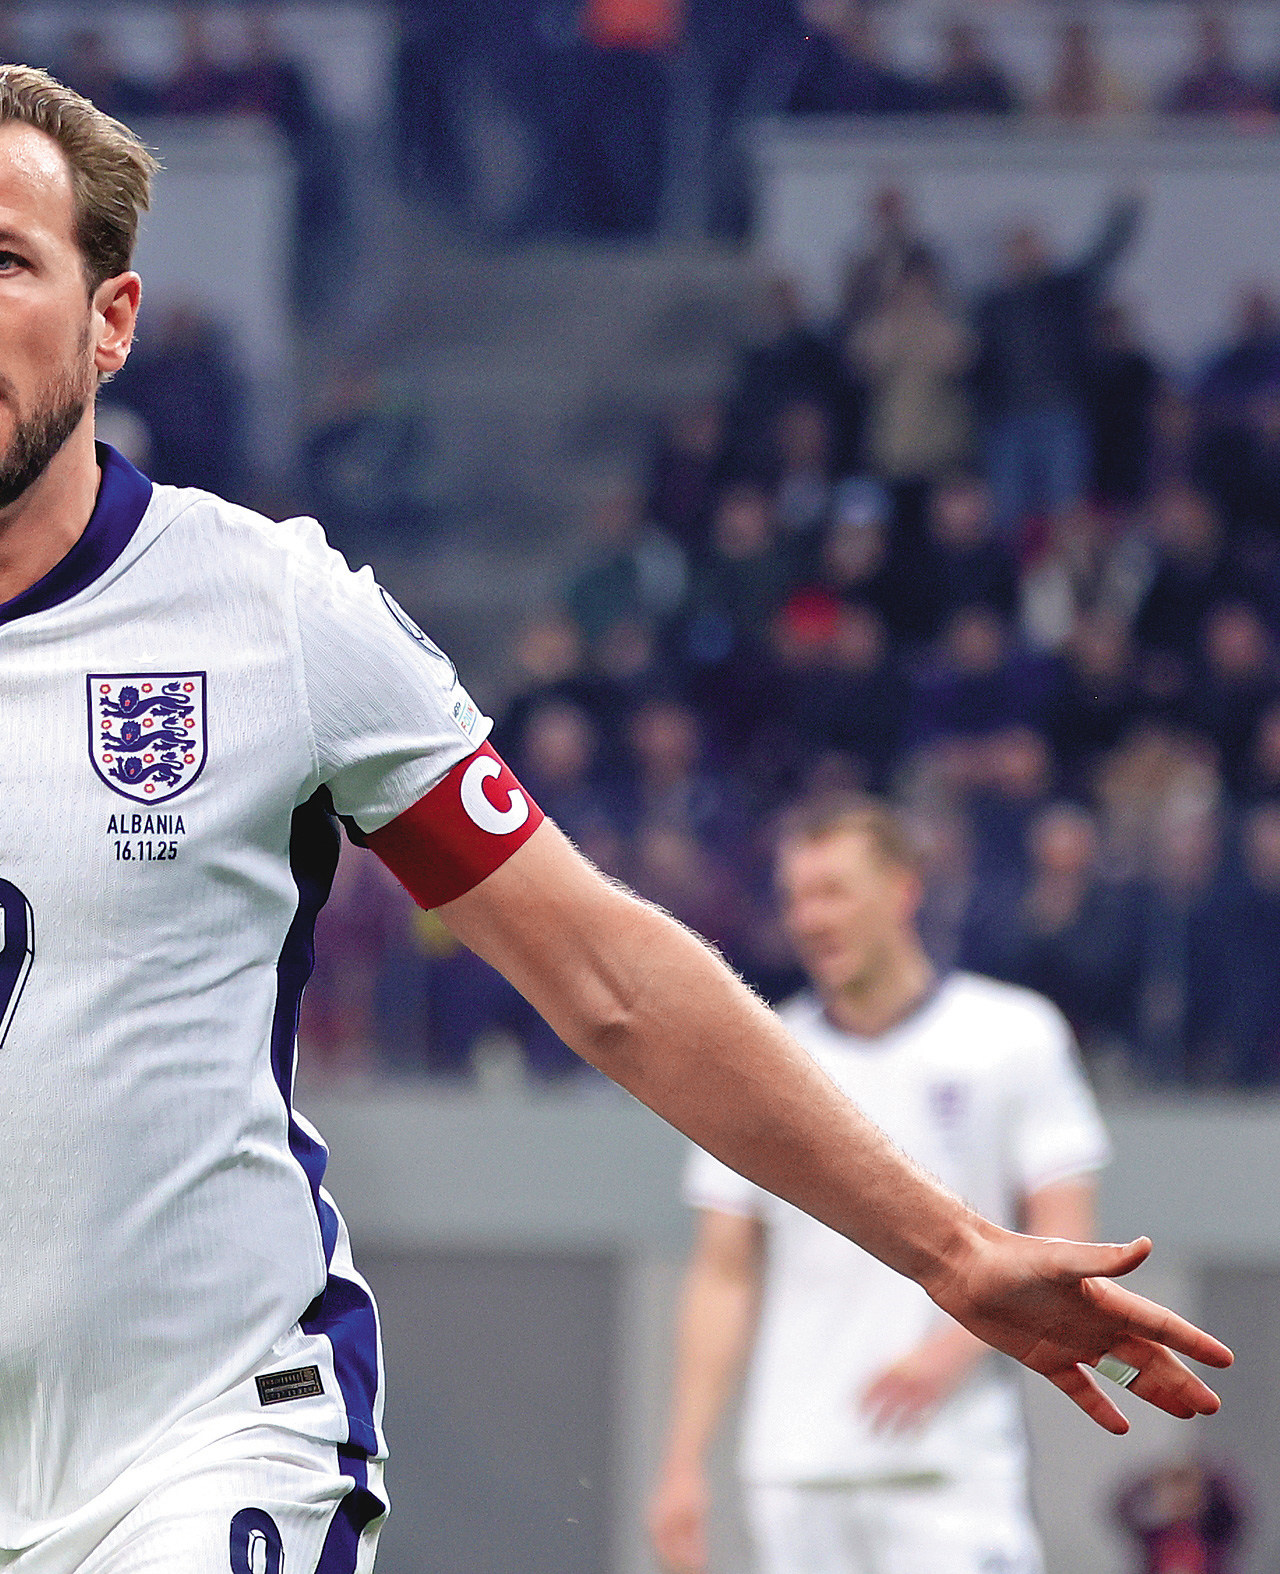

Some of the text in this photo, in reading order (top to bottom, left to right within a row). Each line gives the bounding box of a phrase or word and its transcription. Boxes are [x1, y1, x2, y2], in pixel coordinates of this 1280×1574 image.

[460, 755, 529, 835] C
[107, 814, 185, 834] ALBANIA
[114, 841, 177, 861] 16.11.25
